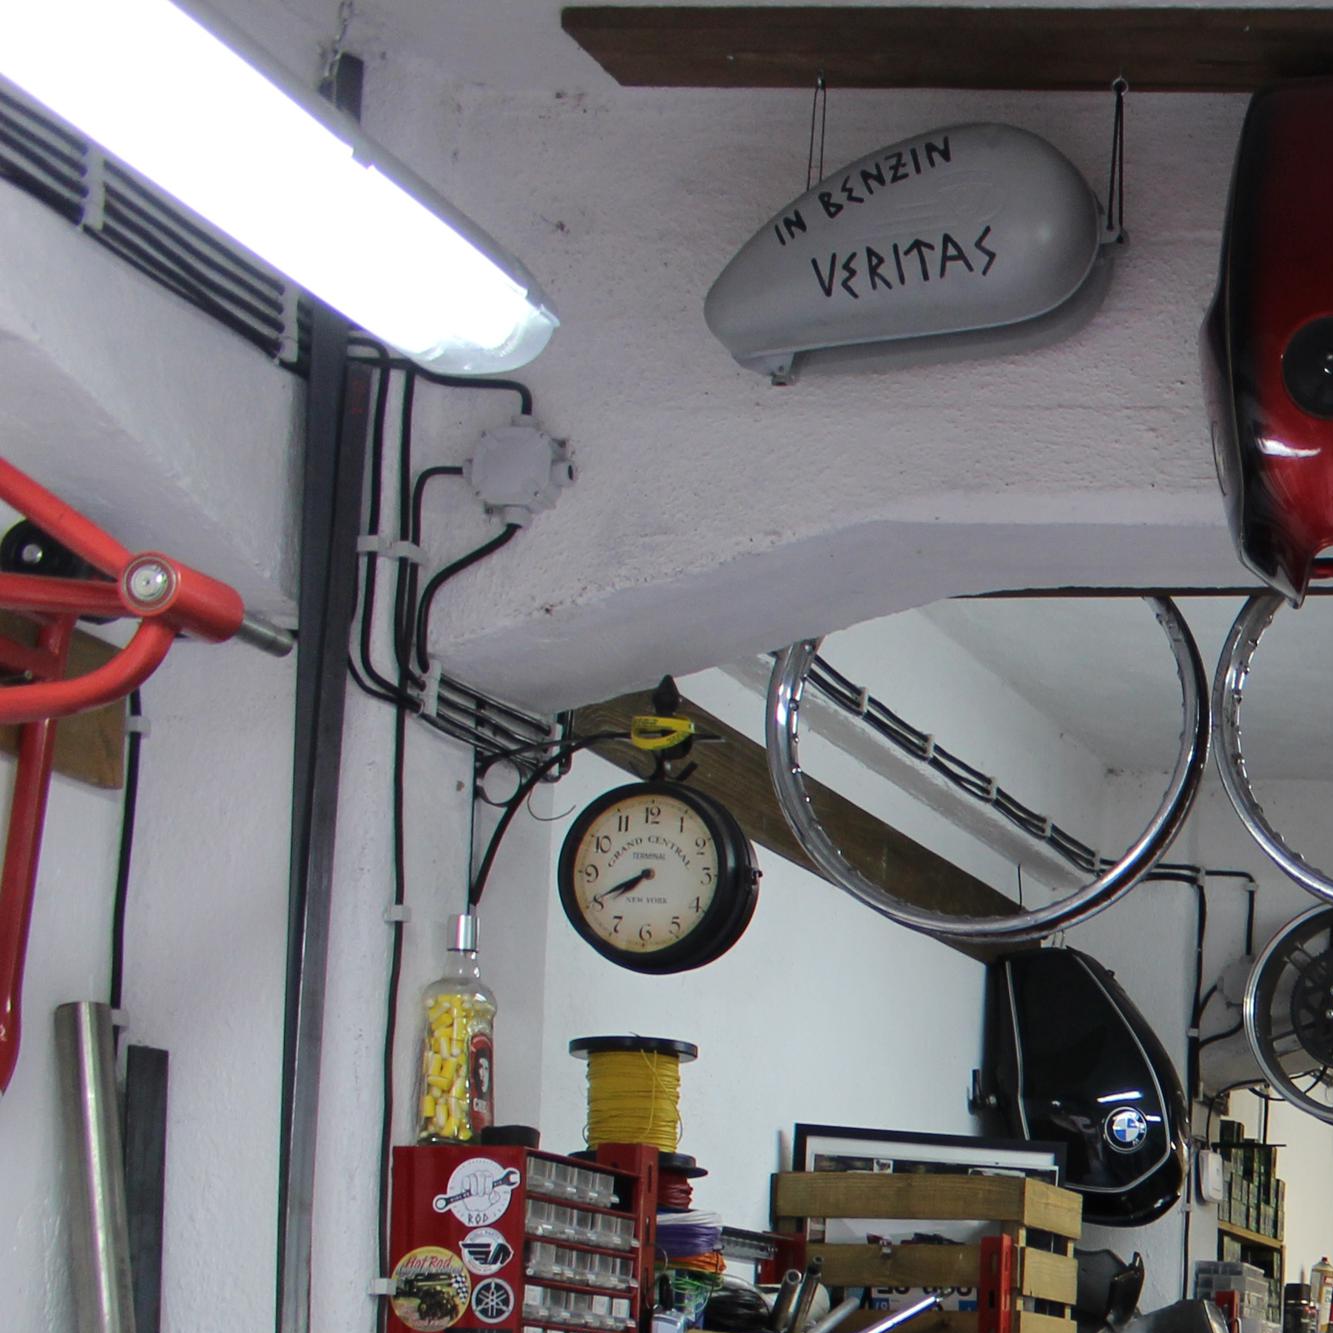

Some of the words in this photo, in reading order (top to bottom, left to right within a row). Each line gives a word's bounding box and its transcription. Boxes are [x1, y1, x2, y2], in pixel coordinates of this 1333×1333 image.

[775, 210, 808, 246] IN
[818, 136, 953, 220] BENZIN
[811, 225, 998, 300] VERITAS
[617, 815, 630, 832] 11
[645, 806, 662, 825] 12
[595, 835, 613, 854] 10
[607, 836, 643, 868] GRAND
[648, 835, 691, 870] CENTRAL
[695, 838, 707, 856] 2
[585, 864, 599, 883] 9
[700, 867, 712, 886] 3
[591, 895, 605, 912] 8
[688, 896, 701, 913] 4
[612, 915, 624, 934] 7
[639, 923, 653, 942] 6
[669, 916, 681, 935] 5
[467, 1213, 489, 1225] ROD
